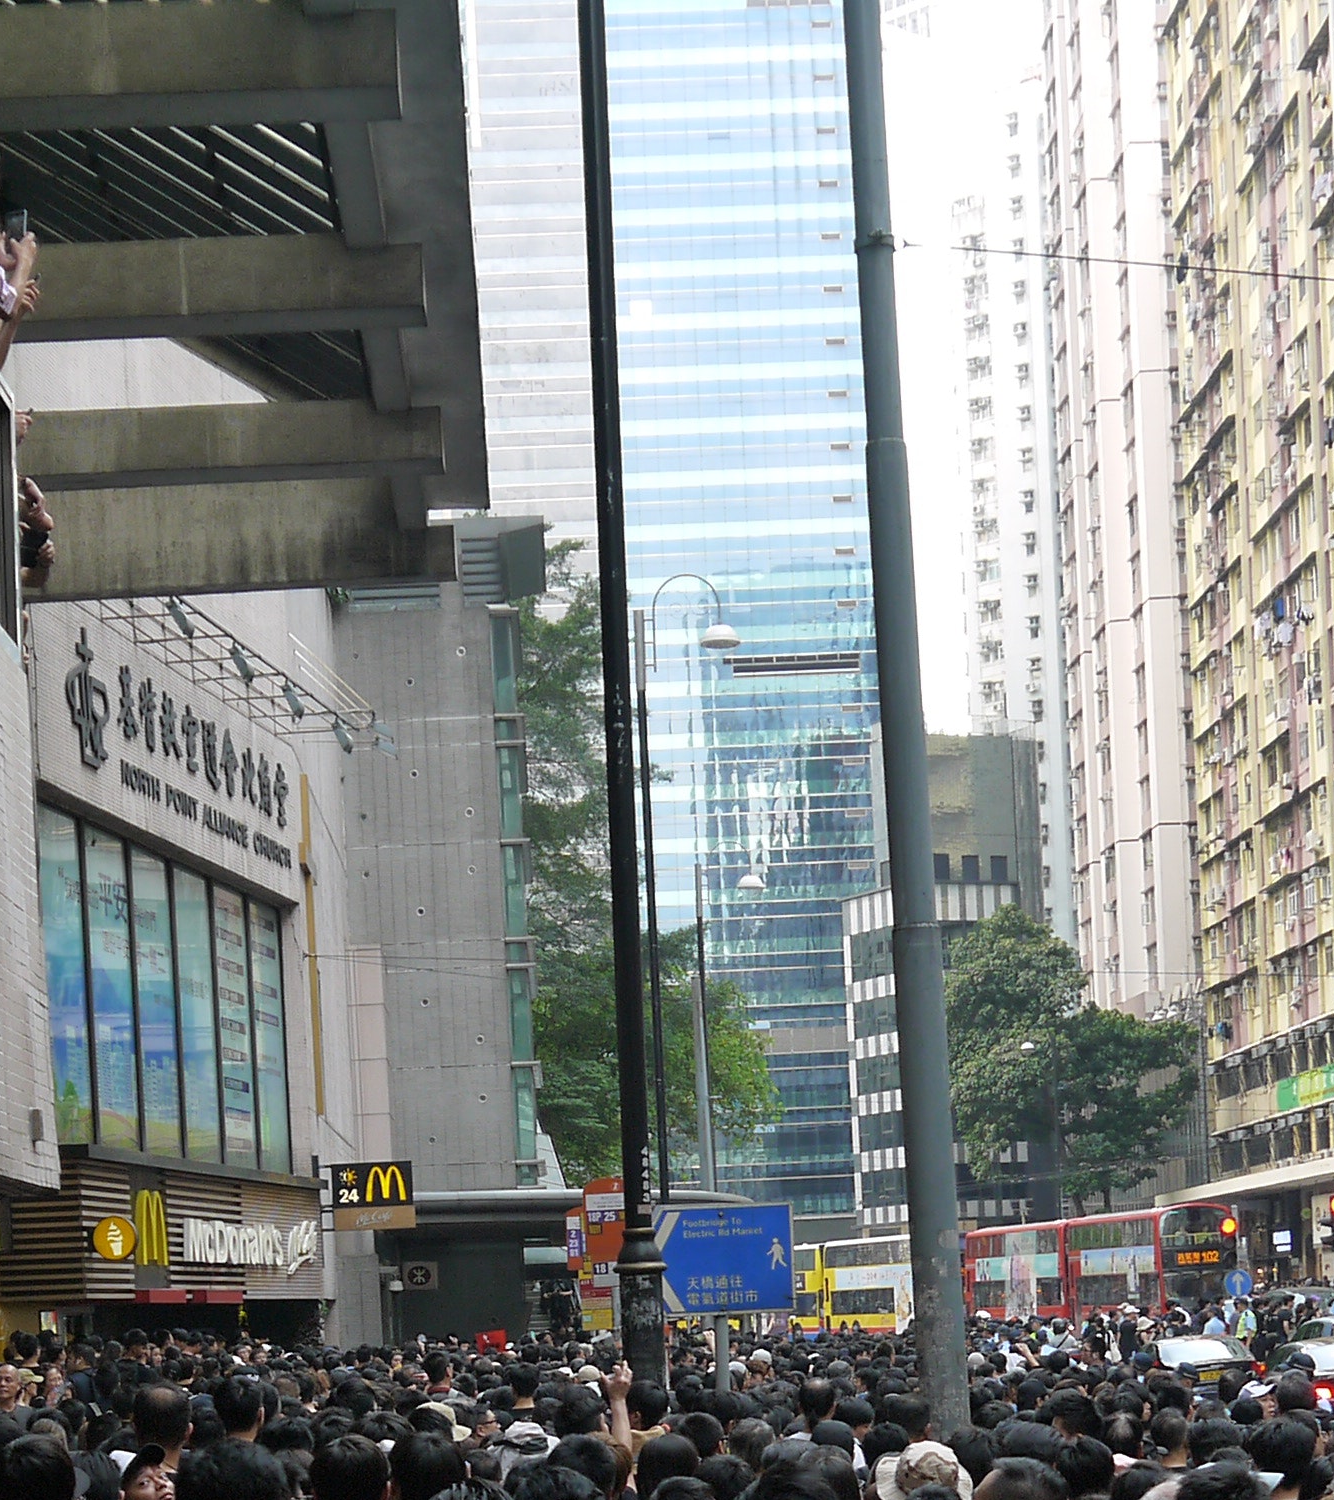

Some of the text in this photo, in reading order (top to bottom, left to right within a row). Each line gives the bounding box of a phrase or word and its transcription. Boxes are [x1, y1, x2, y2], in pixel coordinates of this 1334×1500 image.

[120, 758, 292, 869] NORTH POINT ALLIANCE CHURCH
[339, 1188, 359, 1203] 24
[603, 1211, 616, 1222] 25
[682, 1218, 728, 1229] Footbridge
[683, 1226, 763, 1239] Electric Rd Market
[183, 1217, 284, 1267] McDonald's
[1201, 1249, 1220, 1264] 102
[594, 1263, 607, 1274] 18
[687, 1275, 743, 1291] 天橋通往
[687, 1289, 759, 1306] 電氣道街市
